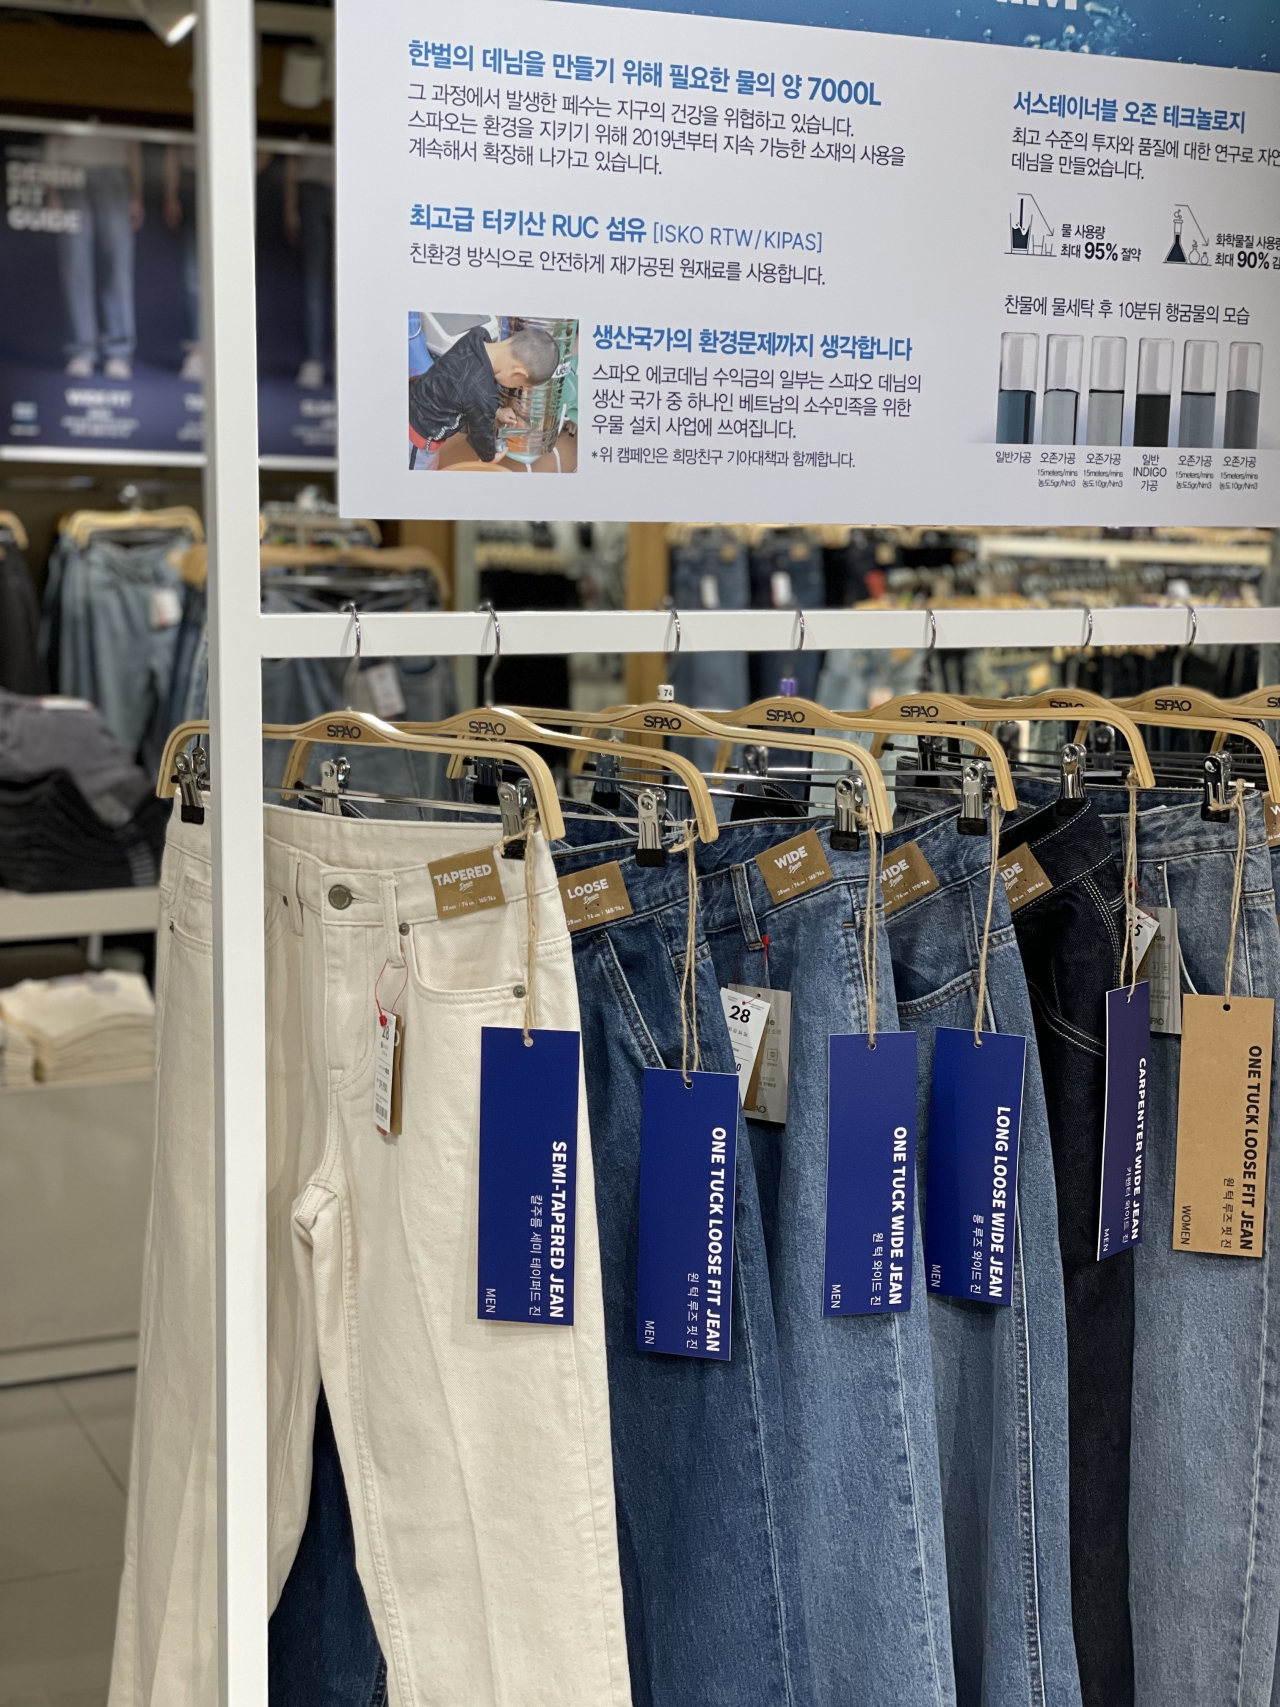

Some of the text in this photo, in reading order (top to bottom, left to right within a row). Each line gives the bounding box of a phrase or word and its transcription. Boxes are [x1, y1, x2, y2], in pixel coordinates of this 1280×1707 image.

[409, 40, 882, 106] 한벌의 데님을 만들기 위해 필요한 물의 양 7000L
[408, 84, 854, 137] 그 과정에서 발생한 페수는 지구의 건강을 위협하고 있습니다.
[1013, 91, 1245, 134] 서스테이너블 오존 테크놀로지
[1012, 127, 1041, 146] 최고
[1045, 130, 1088, 151] 수준의
[1092, 134, 1134, 155] 투자와
[1138, 138, 1179, 159] 품질에
[1184, 142, 1211, 161] 대한
[1215, 144, 1254, 163] 연구로
[1012, 152, 1144, 180] 데님을 만들었습니다.
[410, 204, 822, 253] 최고급 터키산 RUC 섬유 [ISKO RTW/KIPAS]
[1061, 224, 1106, 240] 물 사용량
[1060, 242, 1141, 262] 최대 95% 절약
[1215, 233, 1254, 249] 화학물질
[1215, 251, 1270, 270] 최대 90%
[1005, 295, 1047, 316] 찬물에
[1052, 298, 1095, 318] 물세탁
[1098, 299, 1113, 319] 후
[1119, 302, 1161, 321] 10분뒤
[1223, 307, 1250, 325] 모습
[592, 325, 913, 361] 생산국가의 환경문제까지 생각합니다
[592, 364, 641, 383] 스파오
[646, 365, 707, 386] 에코데님
[713, 368, 774, 388] 수익금의
[780, 370, 824, 390] 일부는
[828, 372, 873, 391] 스파오
[878, 374, 921, 393] 데님의
[617, 447, 855, 468] 캠페인은 희망친구 기아대책과 함께합니다.
[995, 451, 1032, 464] 일반가공
[1040, 452, 1076, 465] 오존가공
[1086, 453, 1121, 466] 오존가공
[1142, 454, 1160, 466] 일반
[1178, 455, 1212, 467] 오존가공
[1223, 456, 1256, 468] 오존가공
[1133, 467, 1167, 478] INDIGO
[1141, 480, 1158, 492] 가공
[664, 688, 673, 697] 74
[766, 709, 805, 723] SPAO
[900, 706, 939, 718] SPAO
[1154, 699, 1192, 711] SPAO
[327, 724, 361, 739] SPAO
[469, 721, 506, 736] SPAO
[643, 714, 683, 732] SPAO
[774, 846, 808, 869] WIDE
[434, 864, 492, 886] TAPERED
[1000, 862, 1023, 881] IDE
[567, 878, 609, 899] LOOSE
[729, 1005, 751, 1023] 28
[1131, 1058, 1146, 1240] CARPENTER WIDE JEAN
[1240, 1046, 1262, 1250] ONE TUCK LOOSE FIT JEAN
[989, 1107, 1011, 1297] LONG LOOSE WIDE JEAN
[1221, 1178, 1234, 1248] 원 턱 루즈 핏 진
[889, 1127, 907, 1304] ONE TUCK WIDE JEAN
[1180, 1205, 1191, 1245] WOMEN
[550, 1141, 567, 1317] SEMI-TAPERED JEAN
[706, 1127, 726, 1352] ONE TUCK LOOSE FIT JEAN
[1122, 1234, 1128, 1243] 진
[529, 1195, 543, 1316] 칼주름 세미 테이퍼드 진
[970, 1214, 984, 1294] 롱 루즈 와이드 진
[870, 1233, 884, 1305] 원 턱 와이드 진
[931, 1264, 941, 1287] MEN
[485, 1288, 496, 1313] MEN
[831, 1284, 841, 1308] MEN
[686, 1272, 699, 1349] 원 턱 루즈 핏 진
[645, 1320, 655, 1344] MEN
